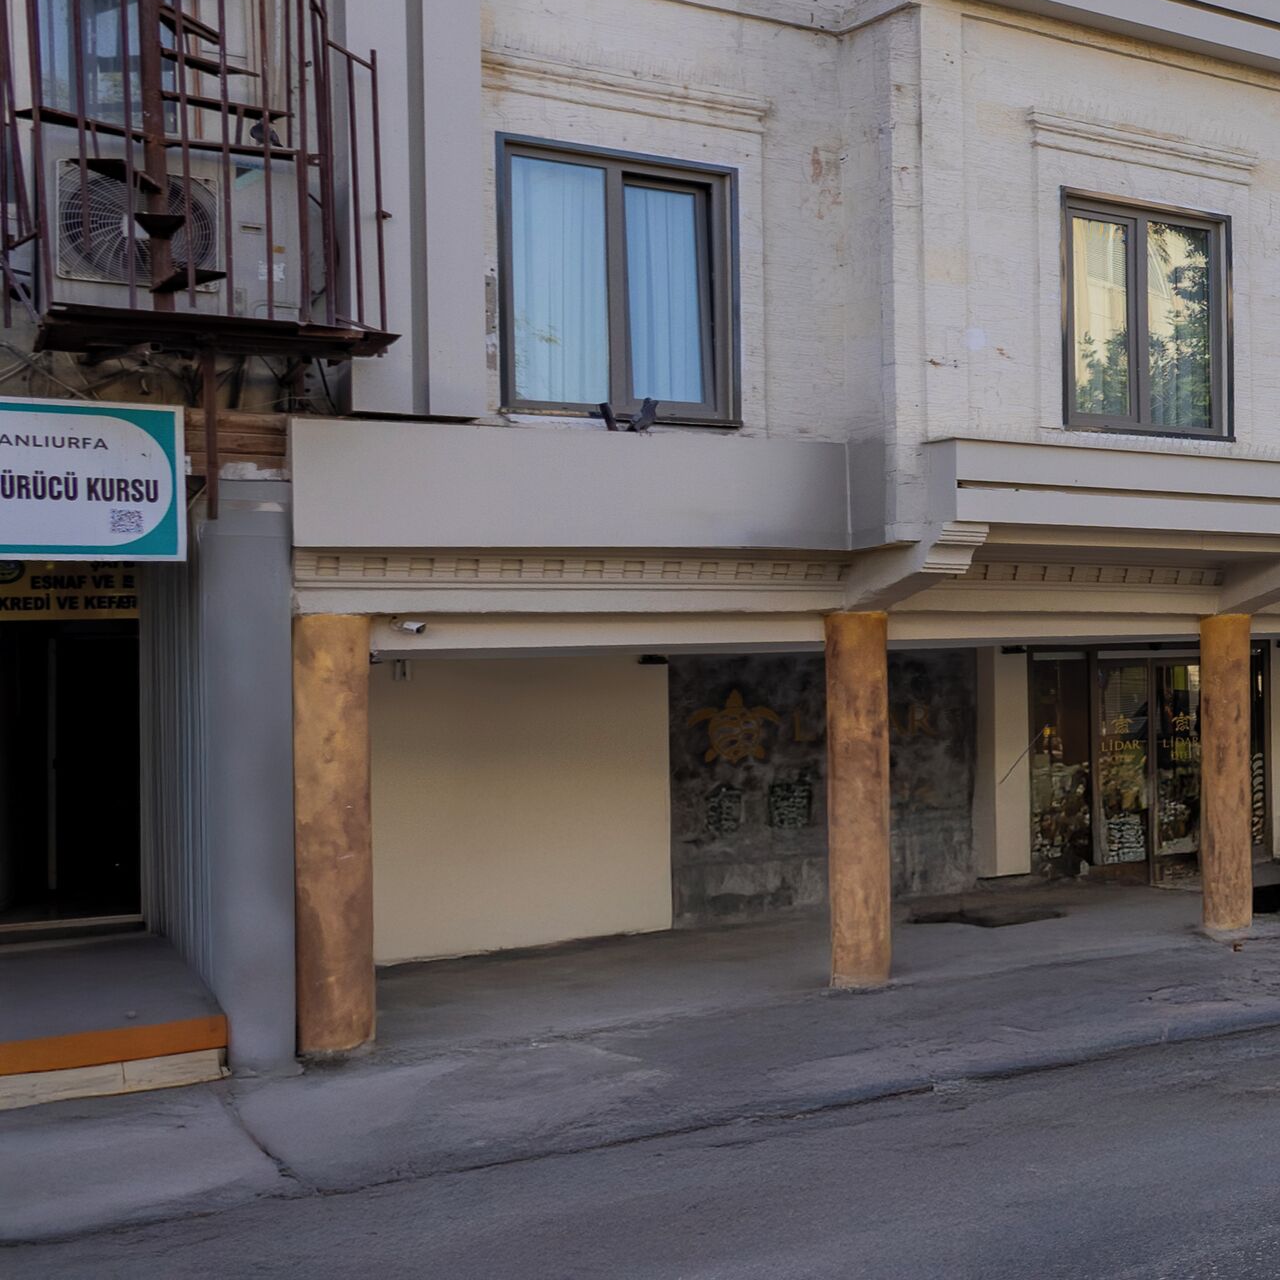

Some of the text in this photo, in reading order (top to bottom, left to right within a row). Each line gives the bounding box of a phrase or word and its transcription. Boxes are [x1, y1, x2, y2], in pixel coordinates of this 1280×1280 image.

[87, 477, 159, 503] KURSU
[30, 575, 86, 590] ESNAF
[92, 575, 115, 589] VE
[0, 593, 50, 611] KREDİ
[56, 596, 79, 610] VE
